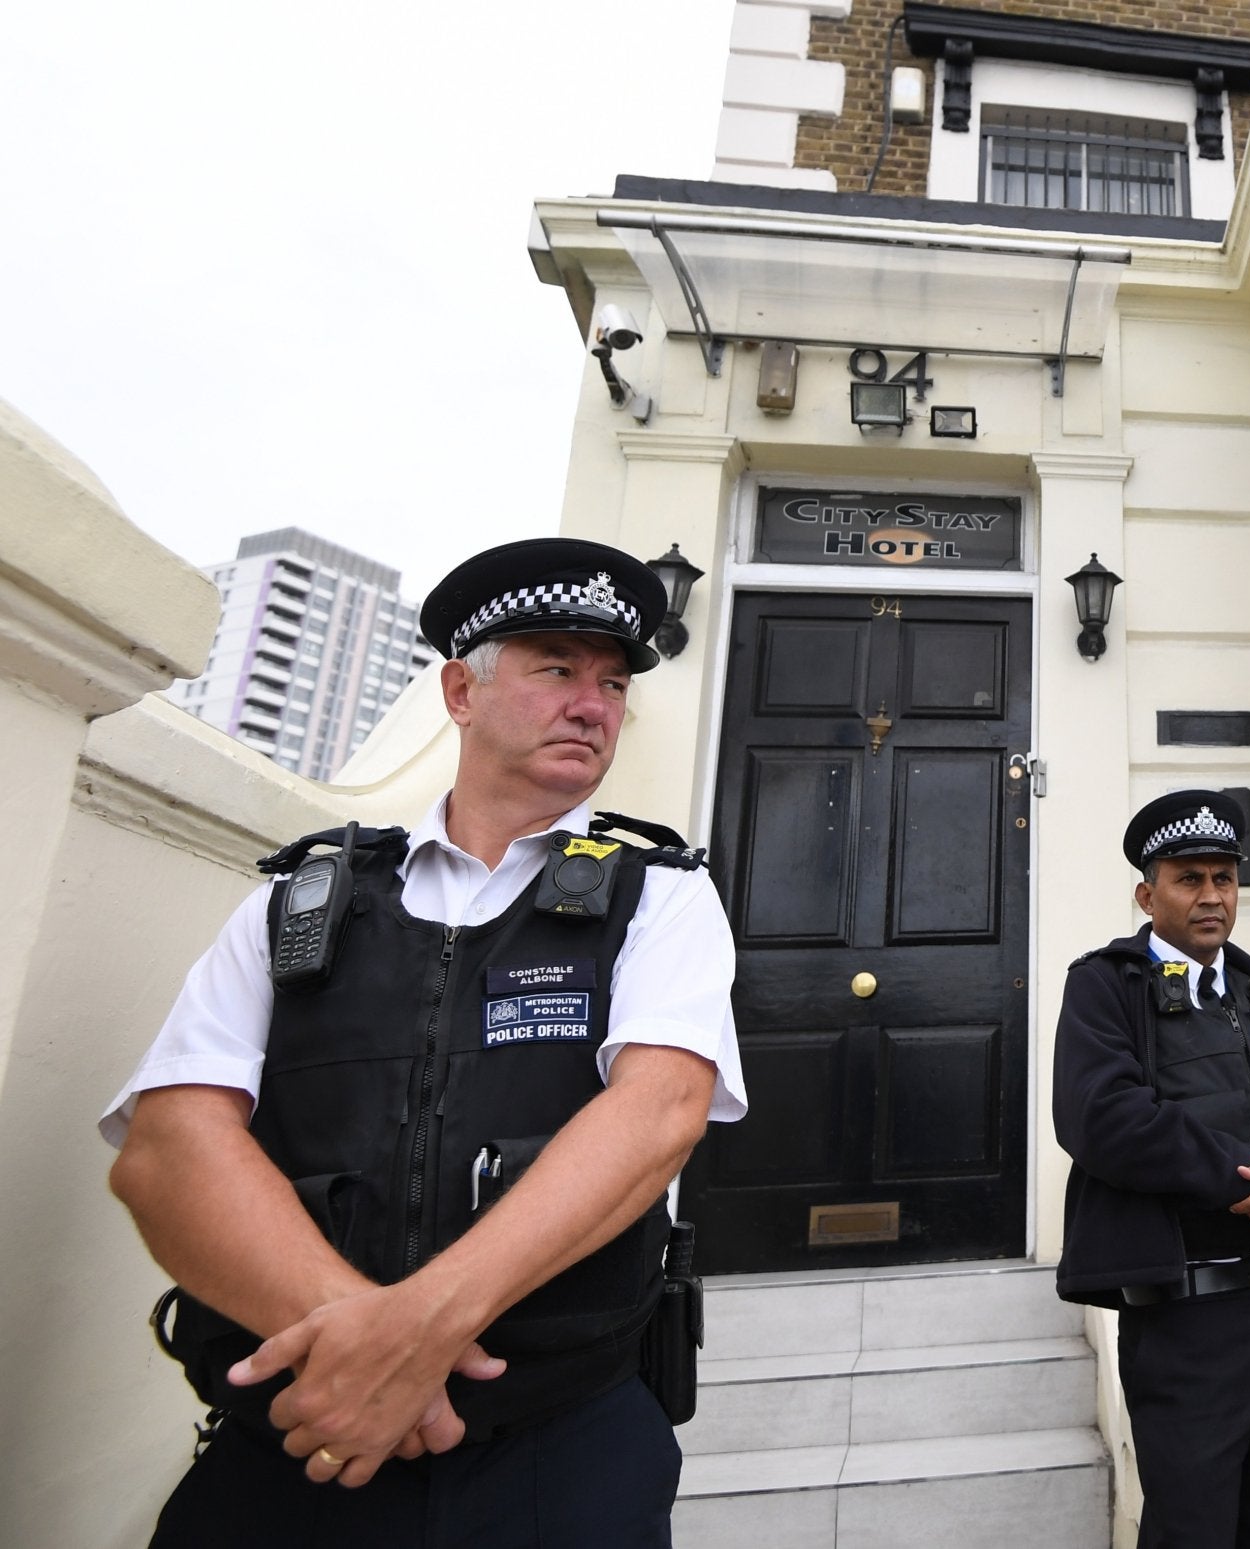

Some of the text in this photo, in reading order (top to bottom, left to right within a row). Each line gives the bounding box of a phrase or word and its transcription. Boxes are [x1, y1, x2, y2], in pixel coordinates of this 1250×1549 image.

[824, 531, 960, 559] HOTEL
[870, 597, 902, 618] 94
[508, 965, 574, 978] CONSTABLE
[519, 974, 564, 985] ALBONE
[525, 997, 582, 1007] METROPOLITAN
[533, 1006, 575, 1015] POLICE
[486, 1024, 588, 1045] POLICE OFFICER
